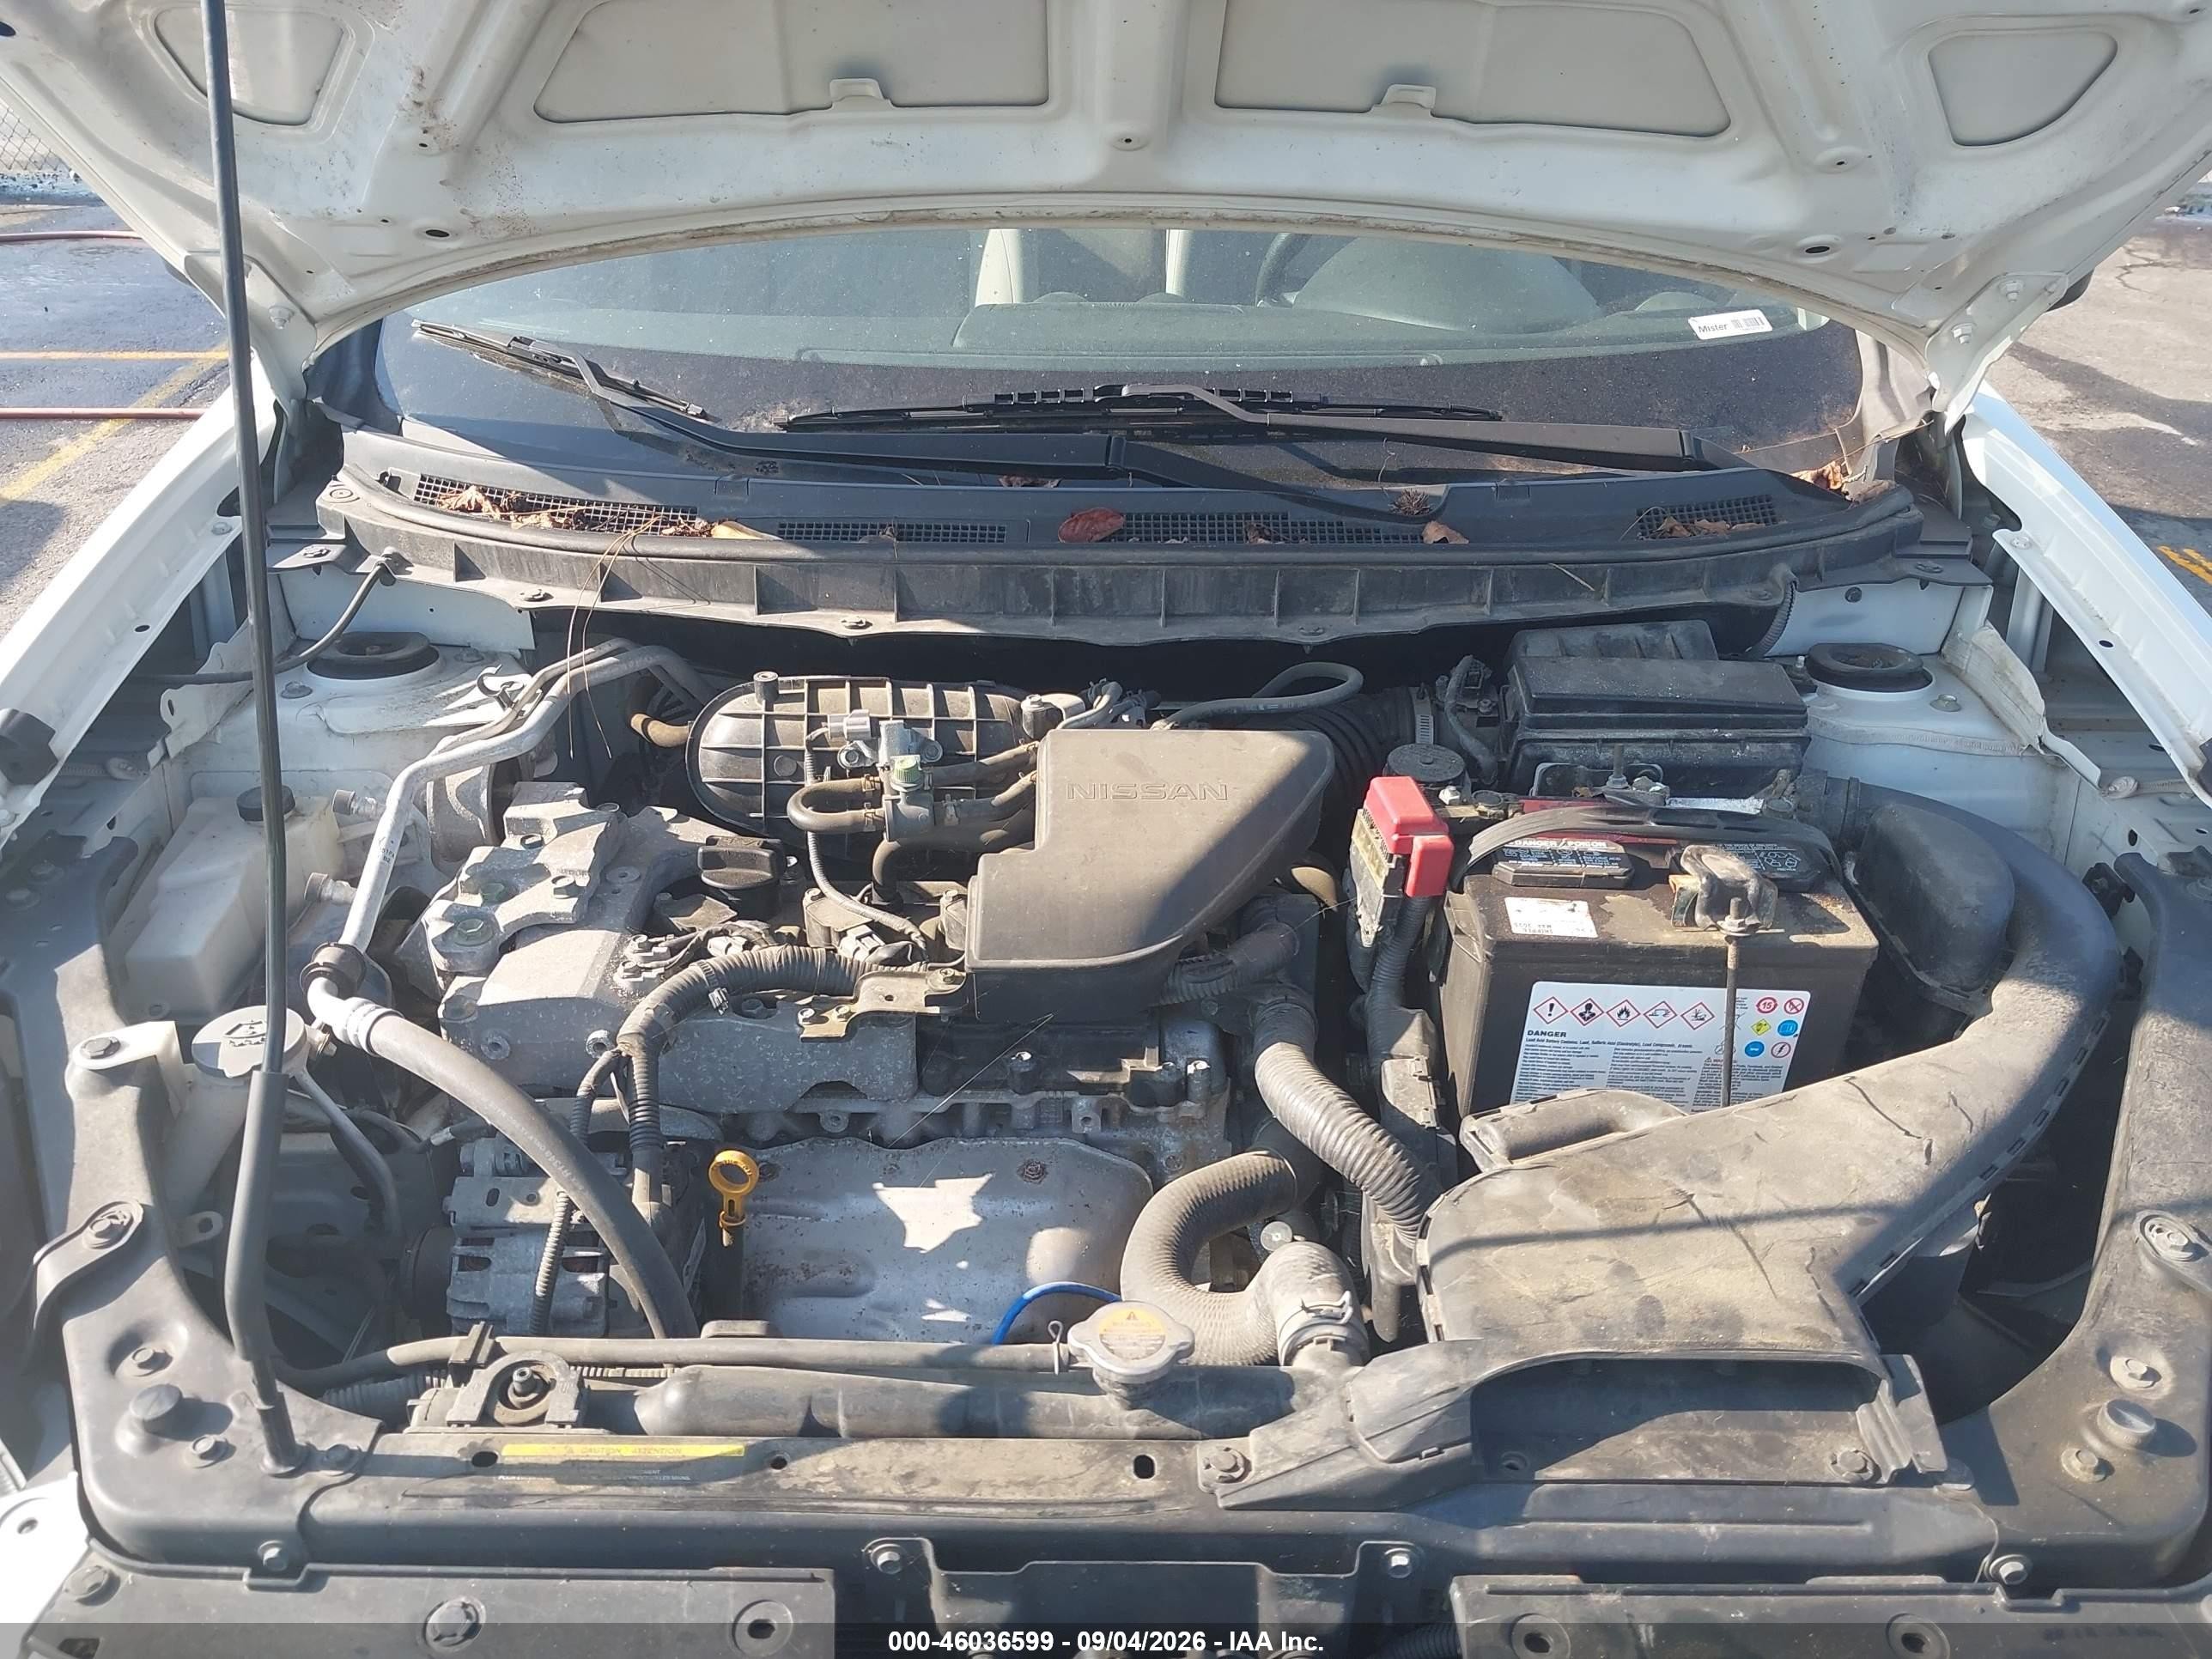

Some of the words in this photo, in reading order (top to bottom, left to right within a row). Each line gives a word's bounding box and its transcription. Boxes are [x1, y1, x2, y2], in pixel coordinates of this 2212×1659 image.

[1698, 324, 1727, 332] Mister
[1066, 782, 1229, 801] NISSAN
[1761, 1001, 1773, 1010] 15
[1527, 1030, 1567, 1038] DANGER
